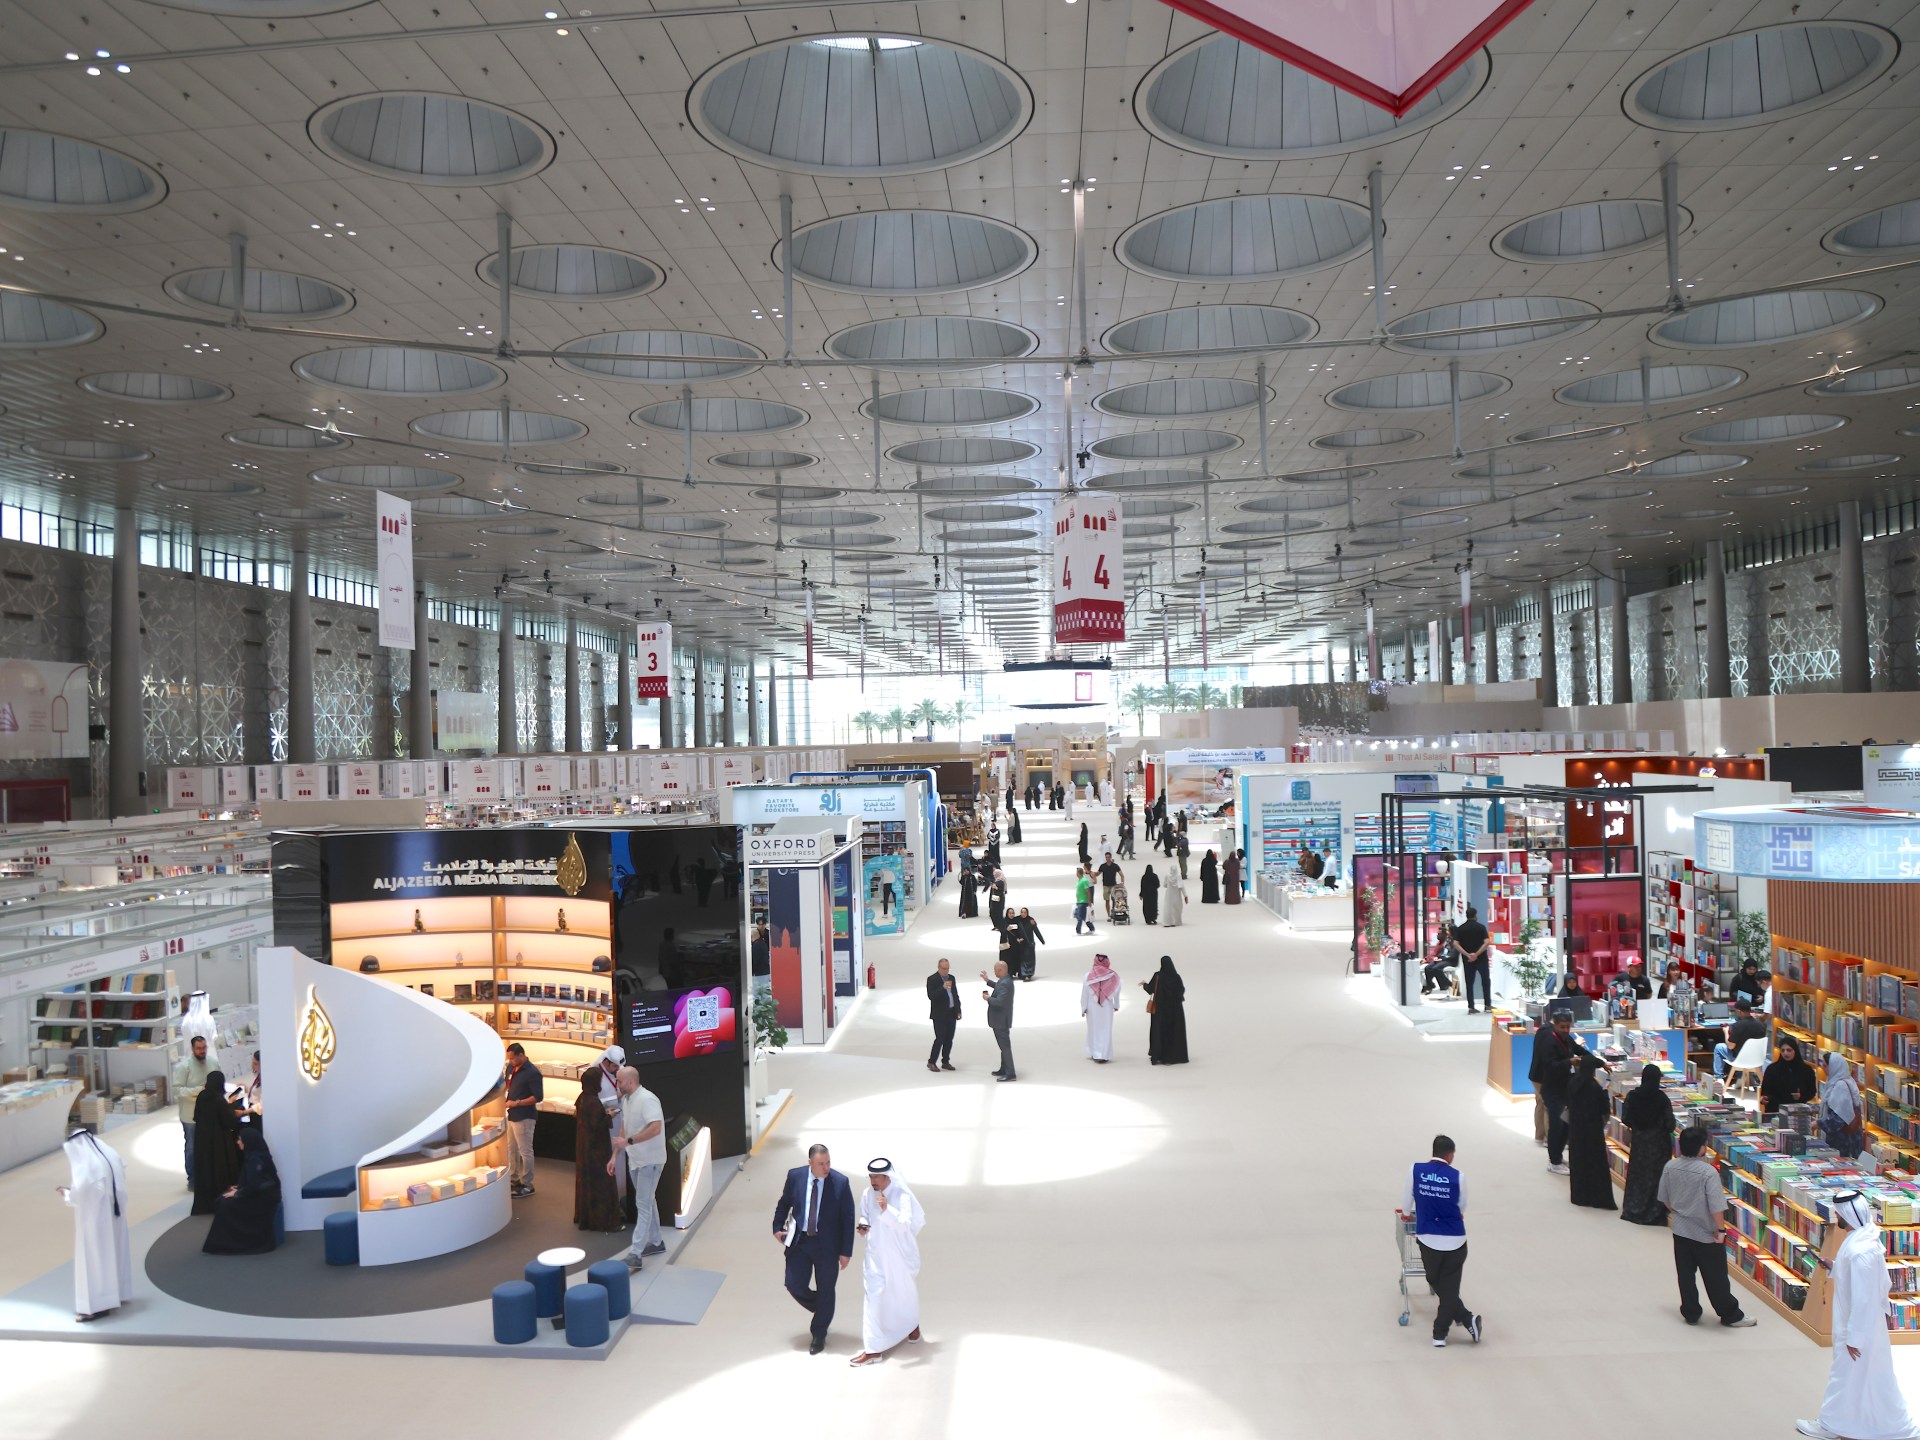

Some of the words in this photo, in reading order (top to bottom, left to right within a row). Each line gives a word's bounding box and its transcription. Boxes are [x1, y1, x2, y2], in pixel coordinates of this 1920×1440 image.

[1063, 556, 1072, 590] 4
[1094, 554, 1110, 589] 4
[648, 652, 658, 671] 3
[750, 838, 816, 850] OXFORD
[481, 859, 523, 873] الجزيرة
[454, 874, 498, 886] MEDIA
[498, 873, 559, 886] NETWORK
[1420, 1173, 1450, 1183] حمالي
